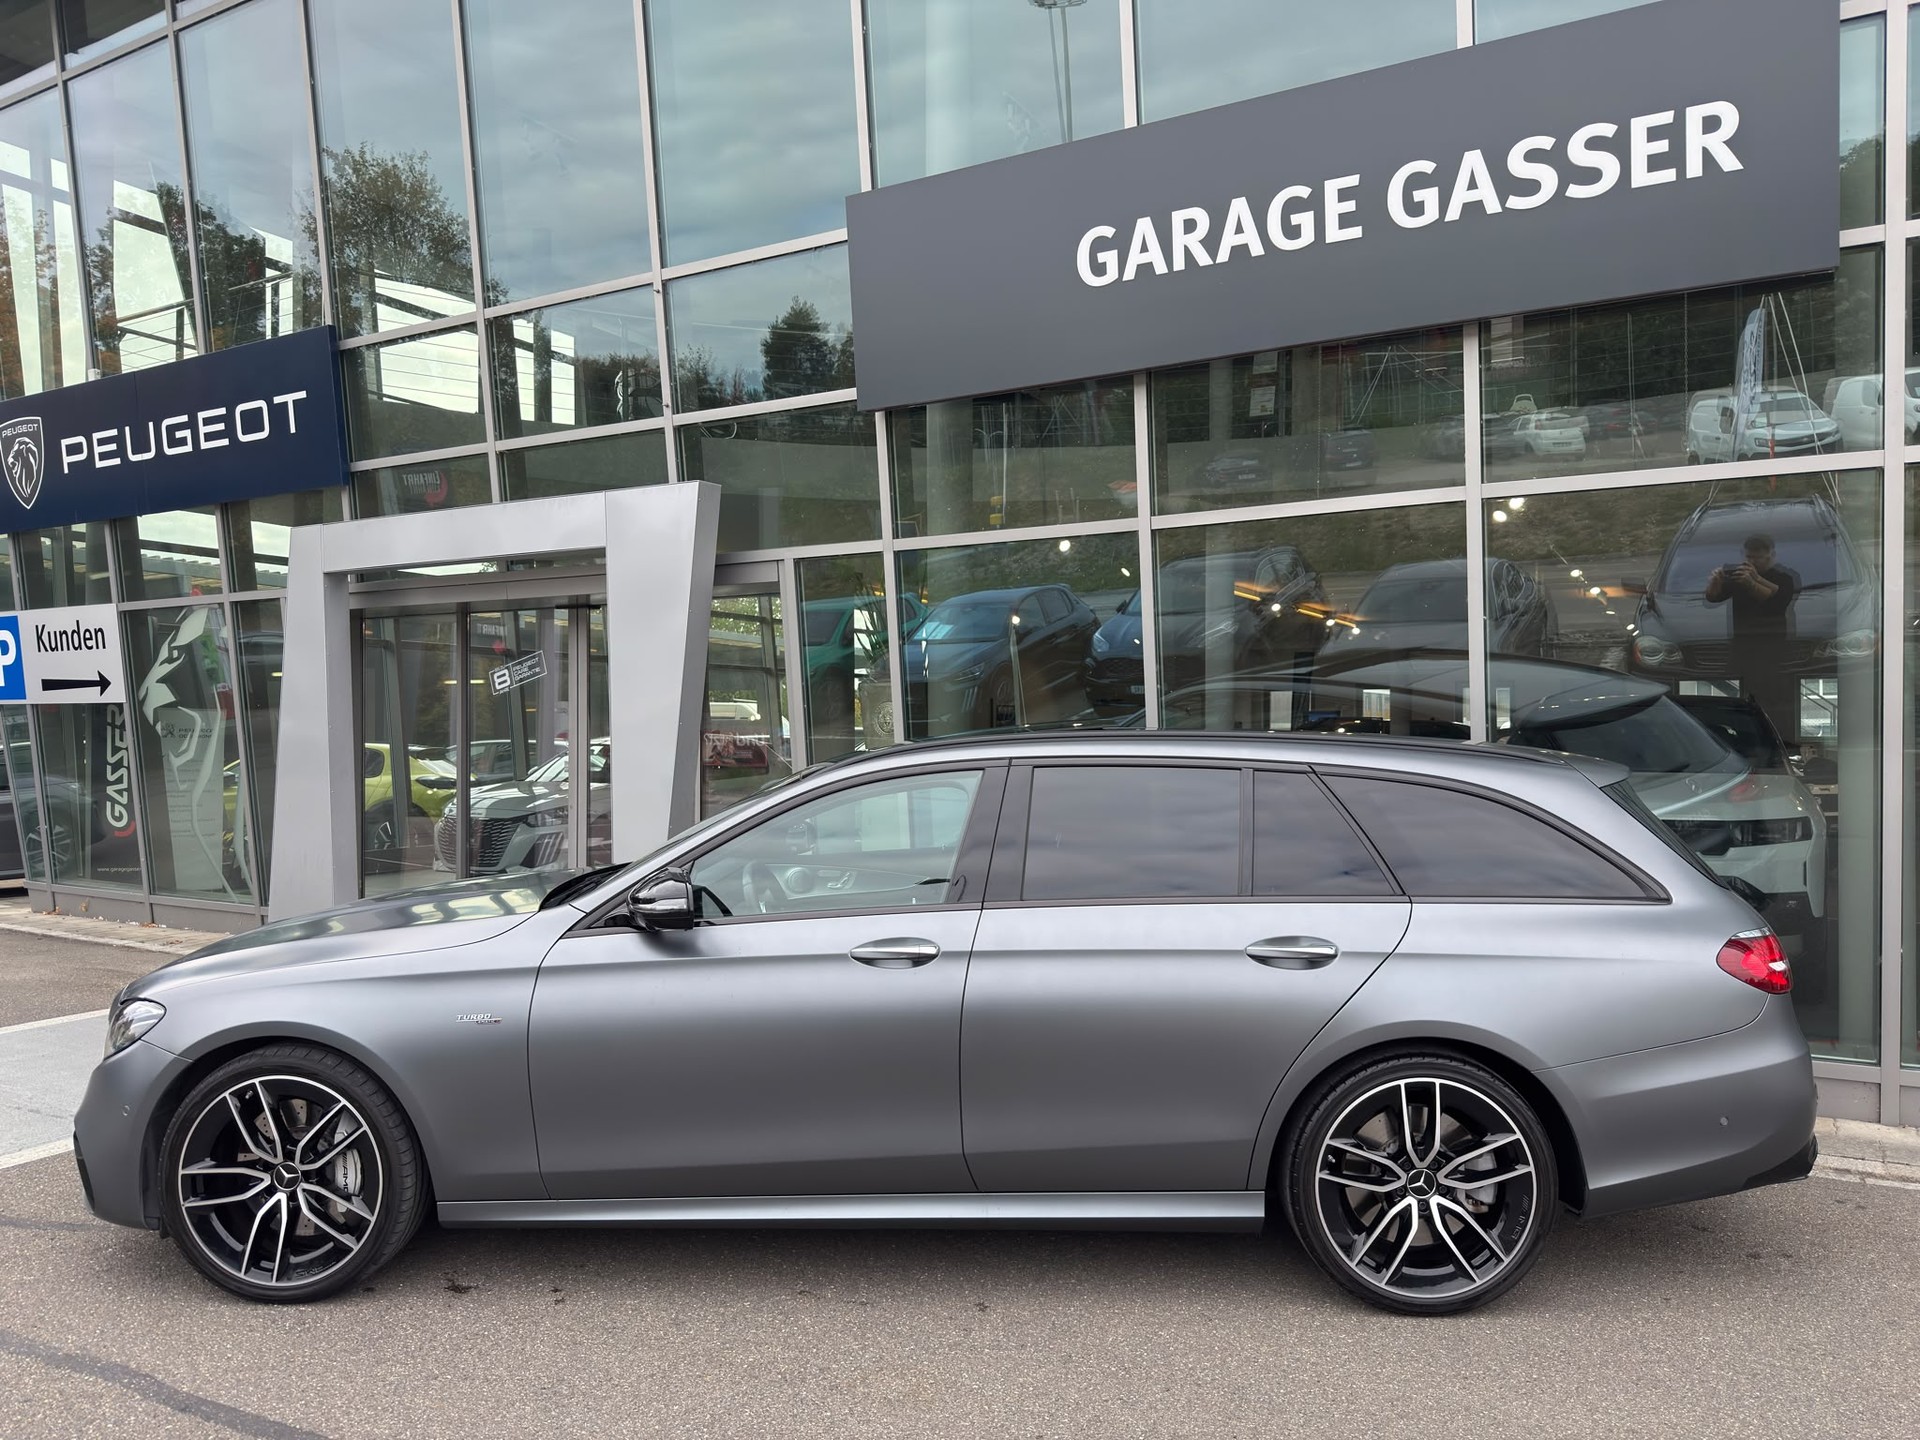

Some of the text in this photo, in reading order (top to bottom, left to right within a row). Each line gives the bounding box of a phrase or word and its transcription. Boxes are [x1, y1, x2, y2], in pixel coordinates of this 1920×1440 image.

[1076, 100, 1744, 287] GARAGE GASSER
[2, 423, 38, 438] PEUGEOT
[61, 390, 307, 474] PEUGEOT
[35, 619, 106, 653] Kunden
[493, 668, 511, 690] 8
[106, 704, 128, 828] GASSER
[456, 1013, 492, 1021] TURBO
